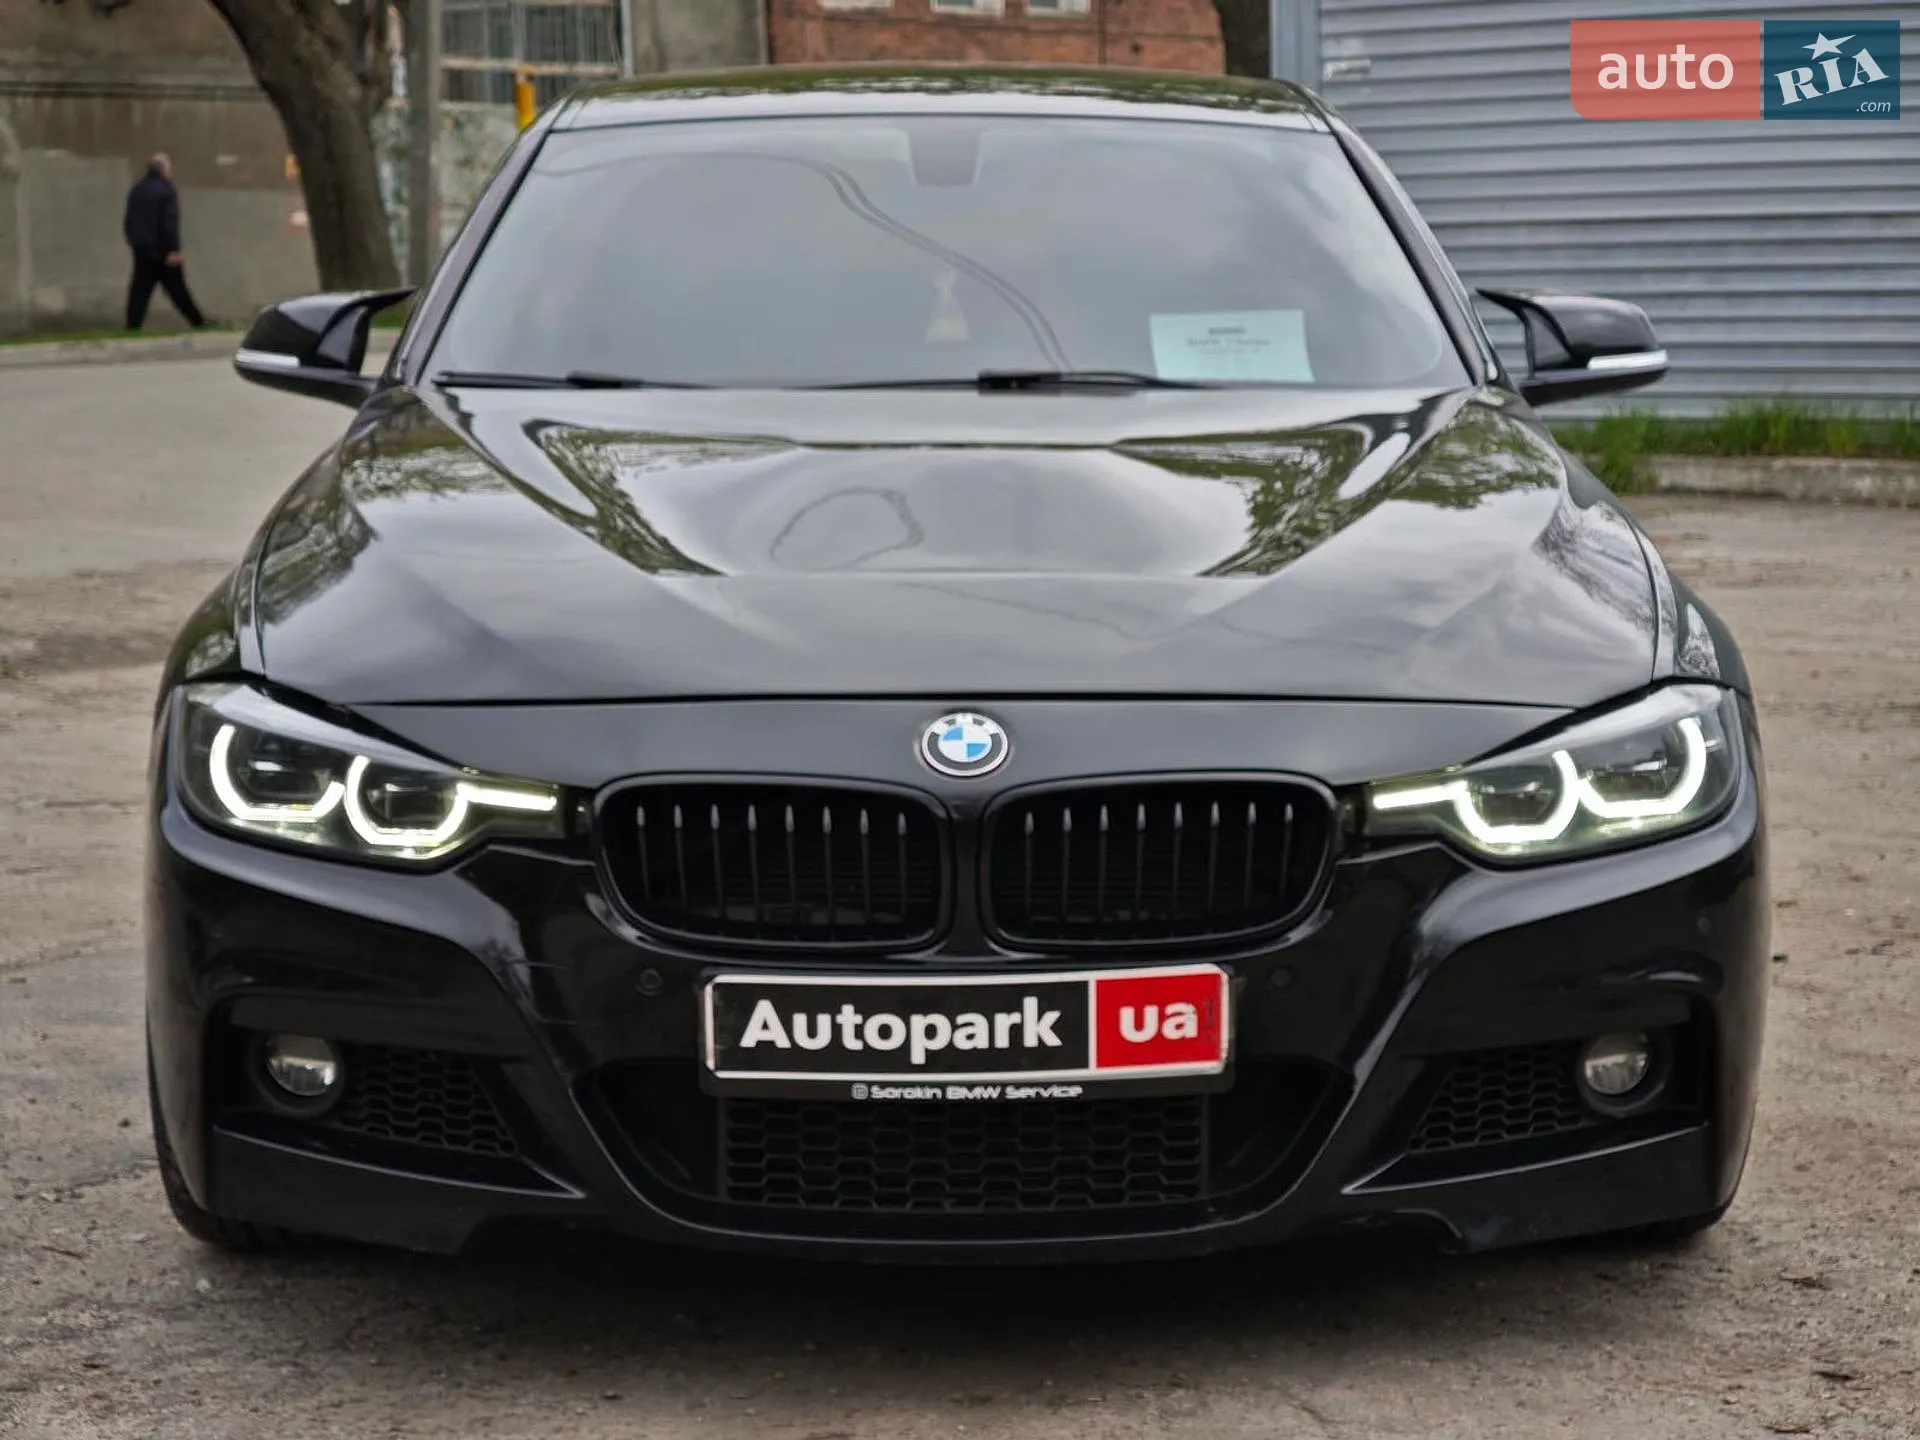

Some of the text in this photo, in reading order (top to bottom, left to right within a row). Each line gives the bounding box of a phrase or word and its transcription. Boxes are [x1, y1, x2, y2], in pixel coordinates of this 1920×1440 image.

[739, 996, 1199, 1065] Autopark ua
[945, 1085, 1002, 1100] BMW
[1004, 1084, 1083, 1099] Service
